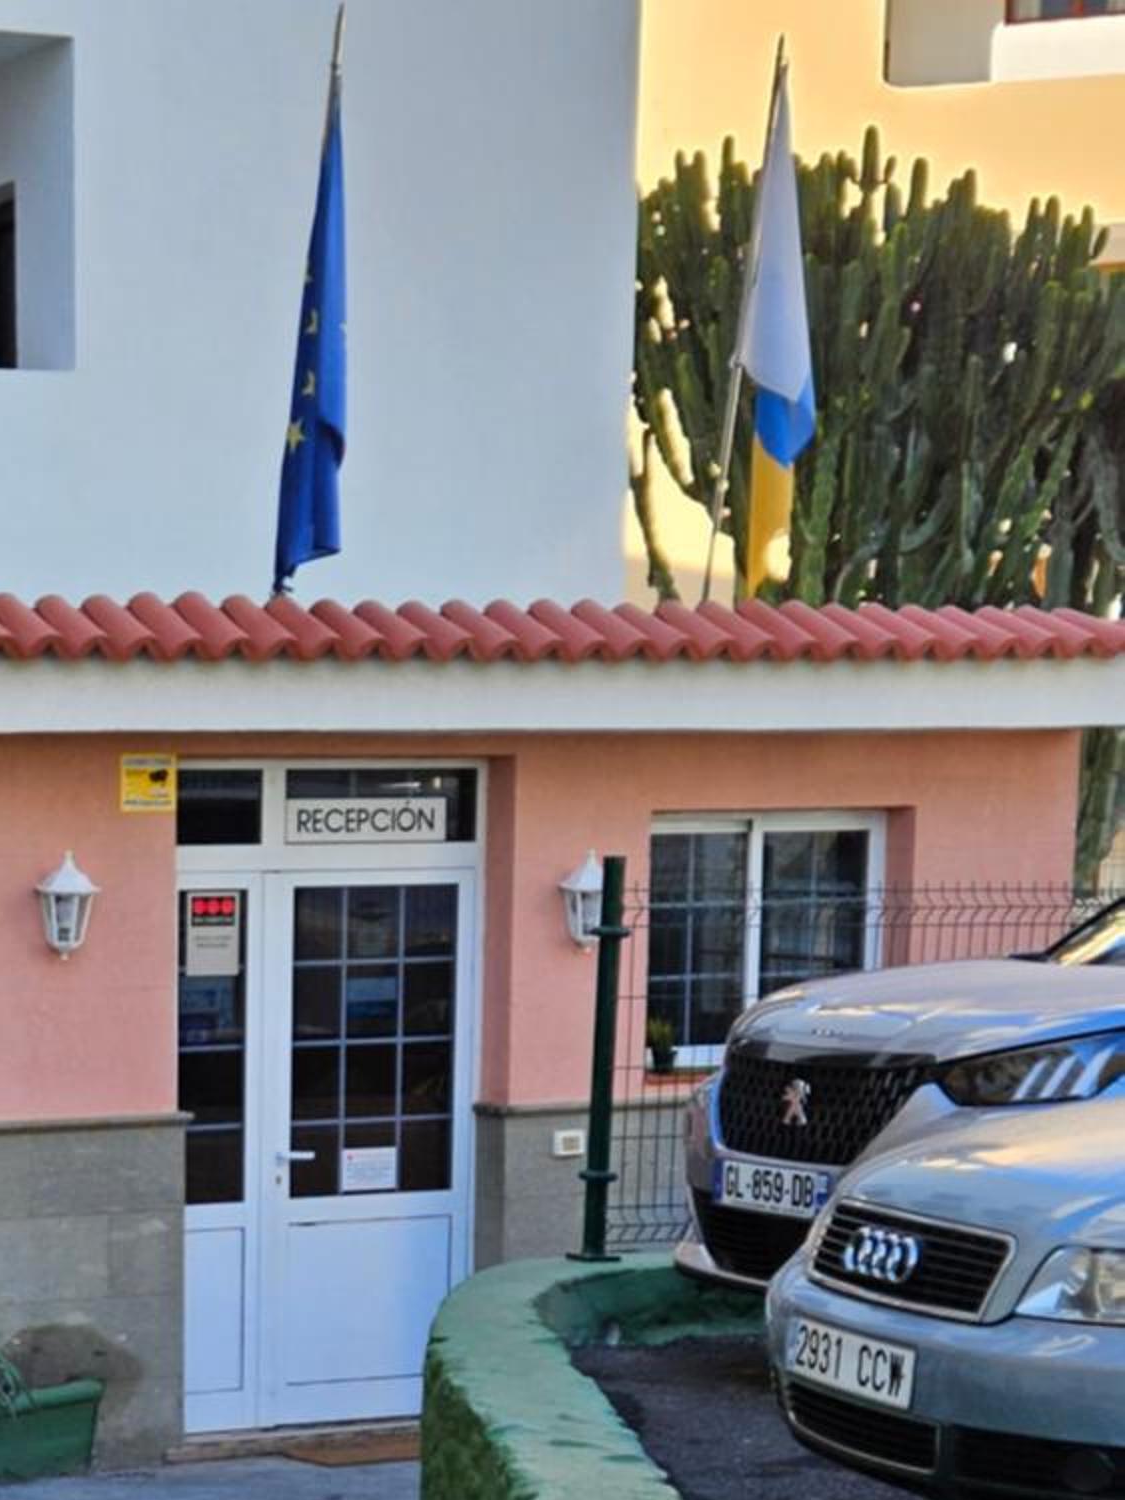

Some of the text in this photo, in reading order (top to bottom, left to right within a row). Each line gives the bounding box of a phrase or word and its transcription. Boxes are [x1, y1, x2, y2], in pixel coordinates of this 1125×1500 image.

[297, 800, 435, 833] RECEPCIÓN
[726, 1165, 814, 1208] GL-859-DB
[795, 1325, 843, 1380] 2931
